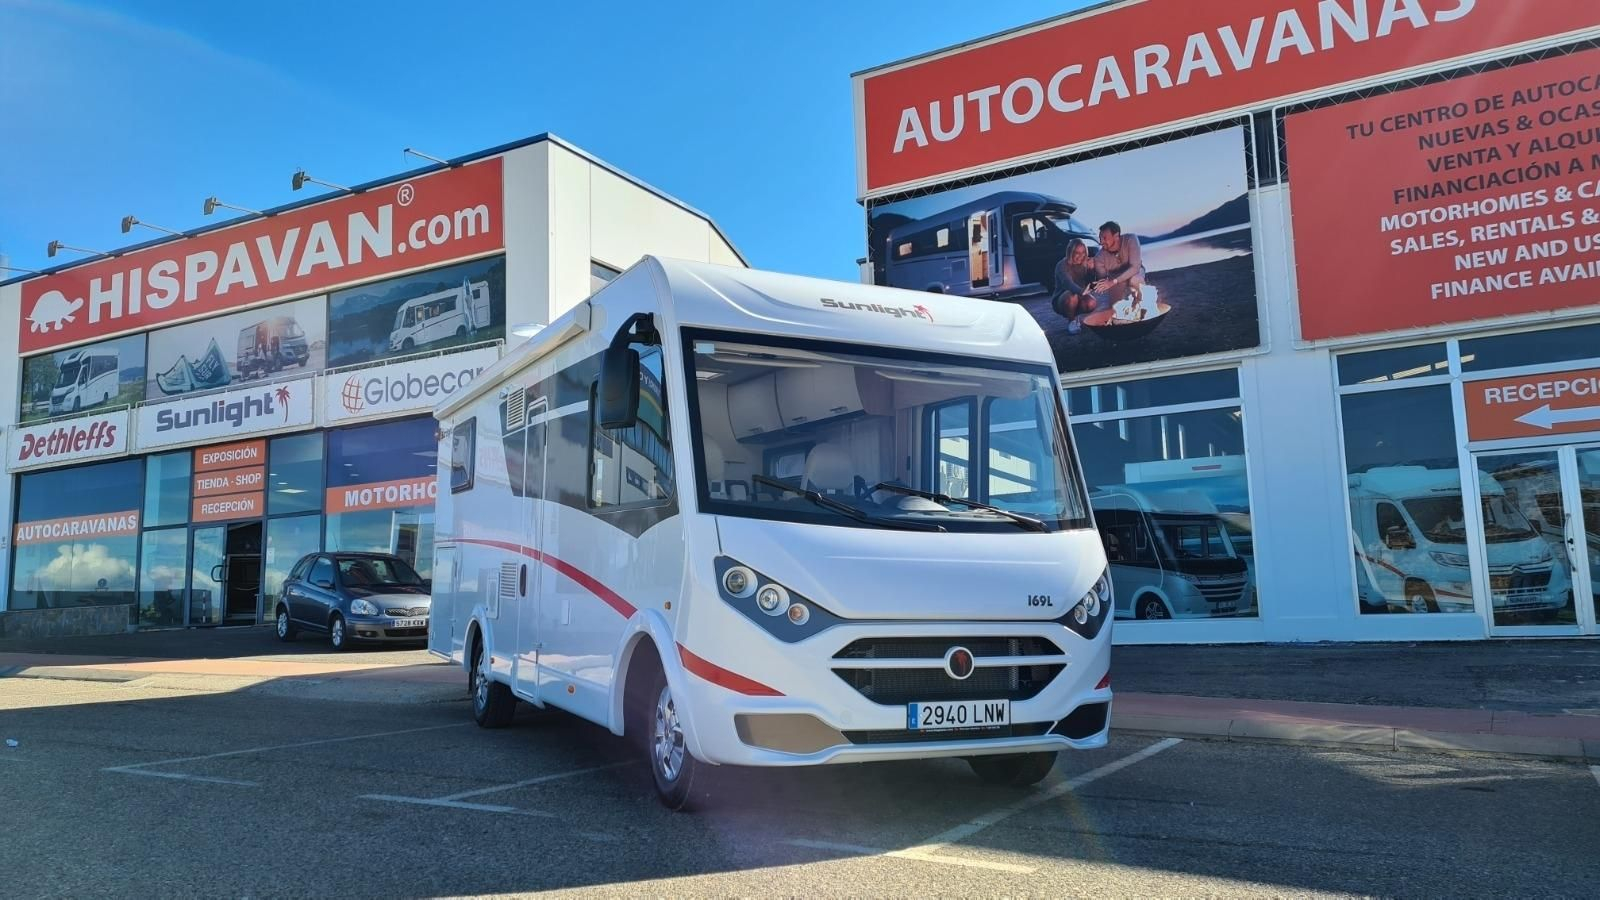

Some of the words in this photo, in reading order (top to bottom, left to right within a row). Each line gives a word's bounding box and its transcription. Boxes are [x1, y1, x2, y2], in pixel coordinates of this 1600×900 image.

[1346, 121, 1374, 141] TU
[1380, 100, 1468, 134] CENTRO
[1475, 94, 1505, 114] DE
[1418, 118, 1510, 151] NUEVAS
[1516, 114, 1534, 131] &
[1427, 145, 1502, 174] VENTA
[1506, 141, 1522, 159] Y
[1393, 160, 1561, 205] FINANCIACIÓN
[1567, 157, 1585, 175] A
[1380, 188, 1549, 233] MOTORHOMES
[1554, 185, 1573, 203] &
[1390, 229, 1466, 255] SALES,
[1470, 210, 1576, 243] RENTALS
[1580, 207, 1600, 225] &
[1454, 247, 1508, 272] NEW
[1515, 239, 1569, 263] AND
[1430, 270, 1534, 300] FINANCE
[819, 297, 926, 320] Sunlight
[1484, 377, 1600, 405] RECEPCI
[156, 392, 274, 433] Sunlight
[18, 420, 117, 461] Dethleffs
[203, 445, 258, 465] EXPOSICIÓN
[196, 477, 229, 491] TIENDA
[235, 472, 262, 486] SHOP
[201, 497, 254, 515] RECEPCIÓN
[16, 515, 137, 541] AUTOCARAVANAS
[922, 704, 967, 726] 2940
[973, 703, 1005, 724] LNW
